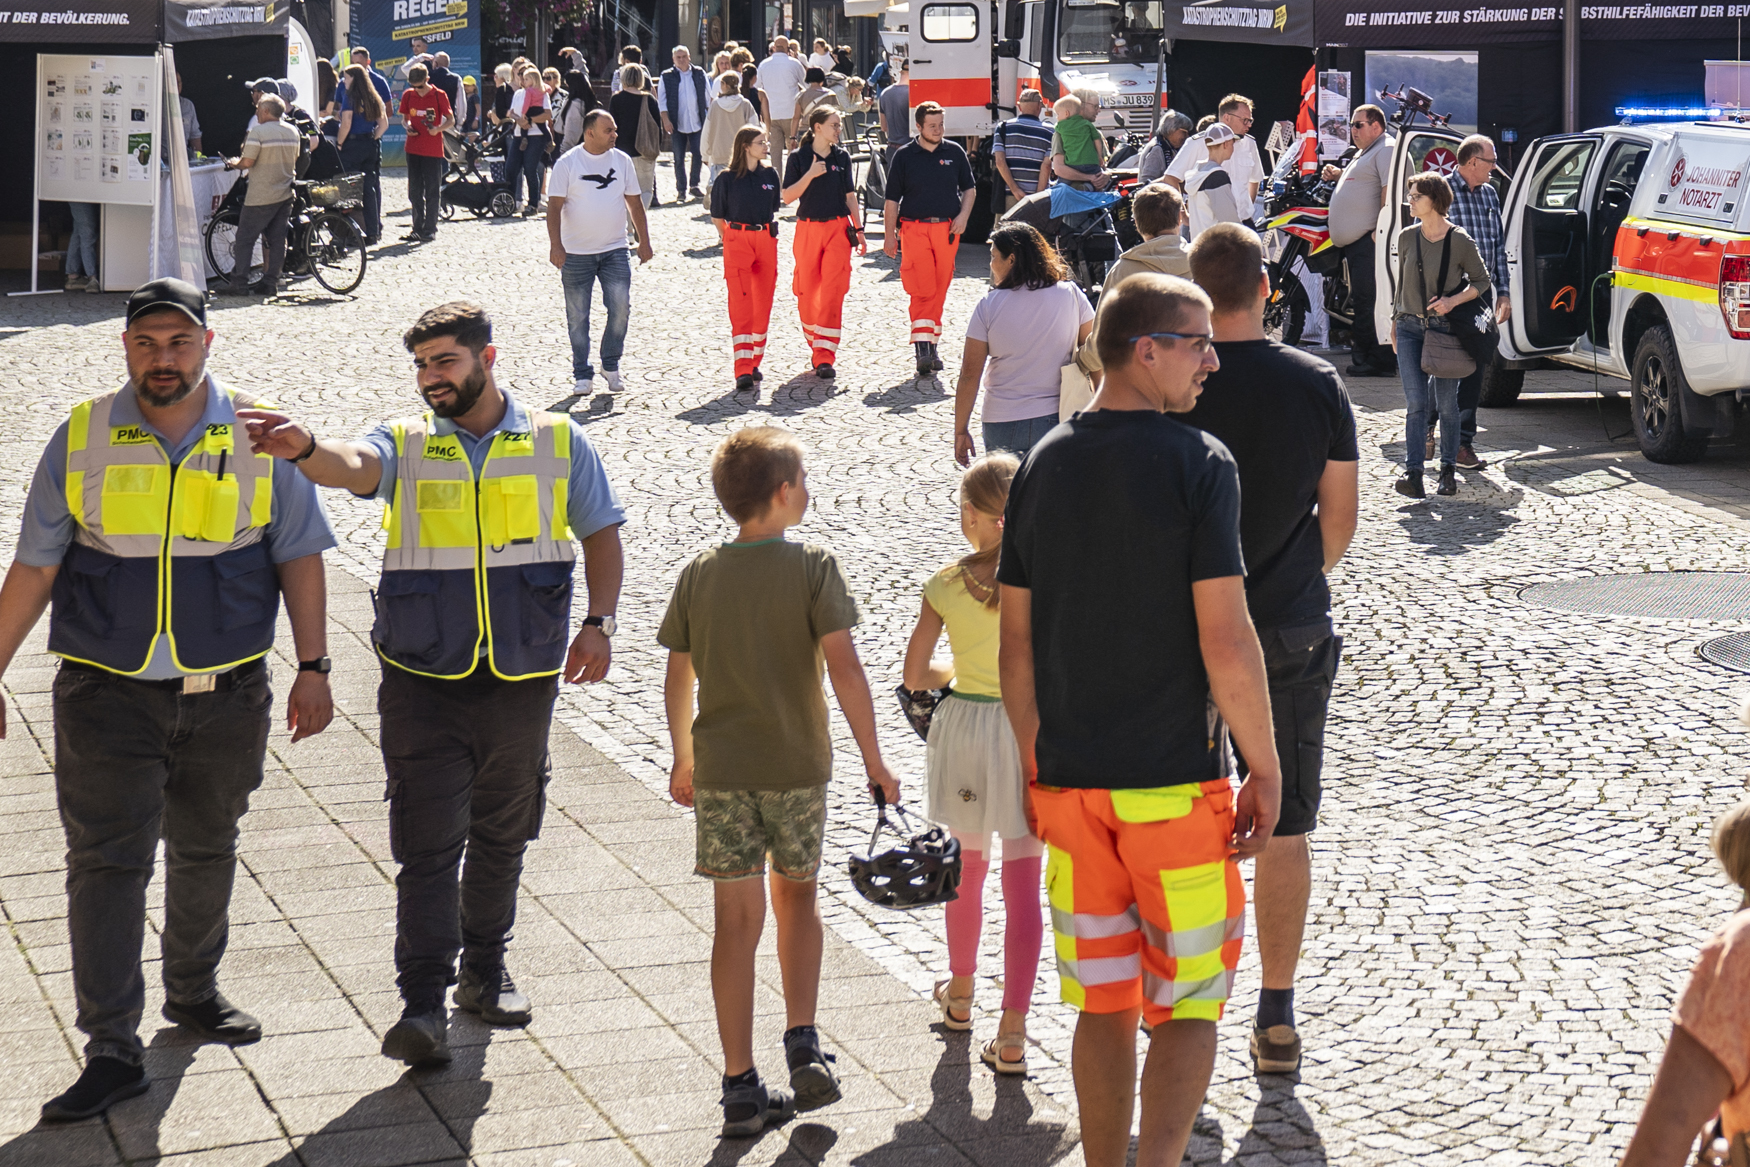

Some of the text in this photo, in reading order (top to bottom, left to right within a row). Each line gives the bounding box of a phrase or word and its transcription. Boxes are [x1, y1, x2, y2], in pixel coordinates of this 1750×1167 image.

[13, 12, 38, 25] DER
[40, 10, 130, 26] BEVÖLKERUNG.
[1182, 6, 1258, 27] KATASTROPHENSCHUTZTAG
[1257, 9, 1274, 28] NRW
[1345, 12, 1367, 26] DIE
[1369, 11, 1432, 26] INITIATIVE
[1435, 11, 1459, 24] ZUR
[1463, 7, 1529, 23] STÄRKUNG
[1530, 7, 1556, 21] DER
[1700, 5, 1724, 18] DER
[1104, 95, 1154, 105] MS JU 839
[1686, 166, 1741, 188] JOHANNITER
[1679, 187, 1722, 210] NOTARZT
[427, 446, 456, 457] PMC
